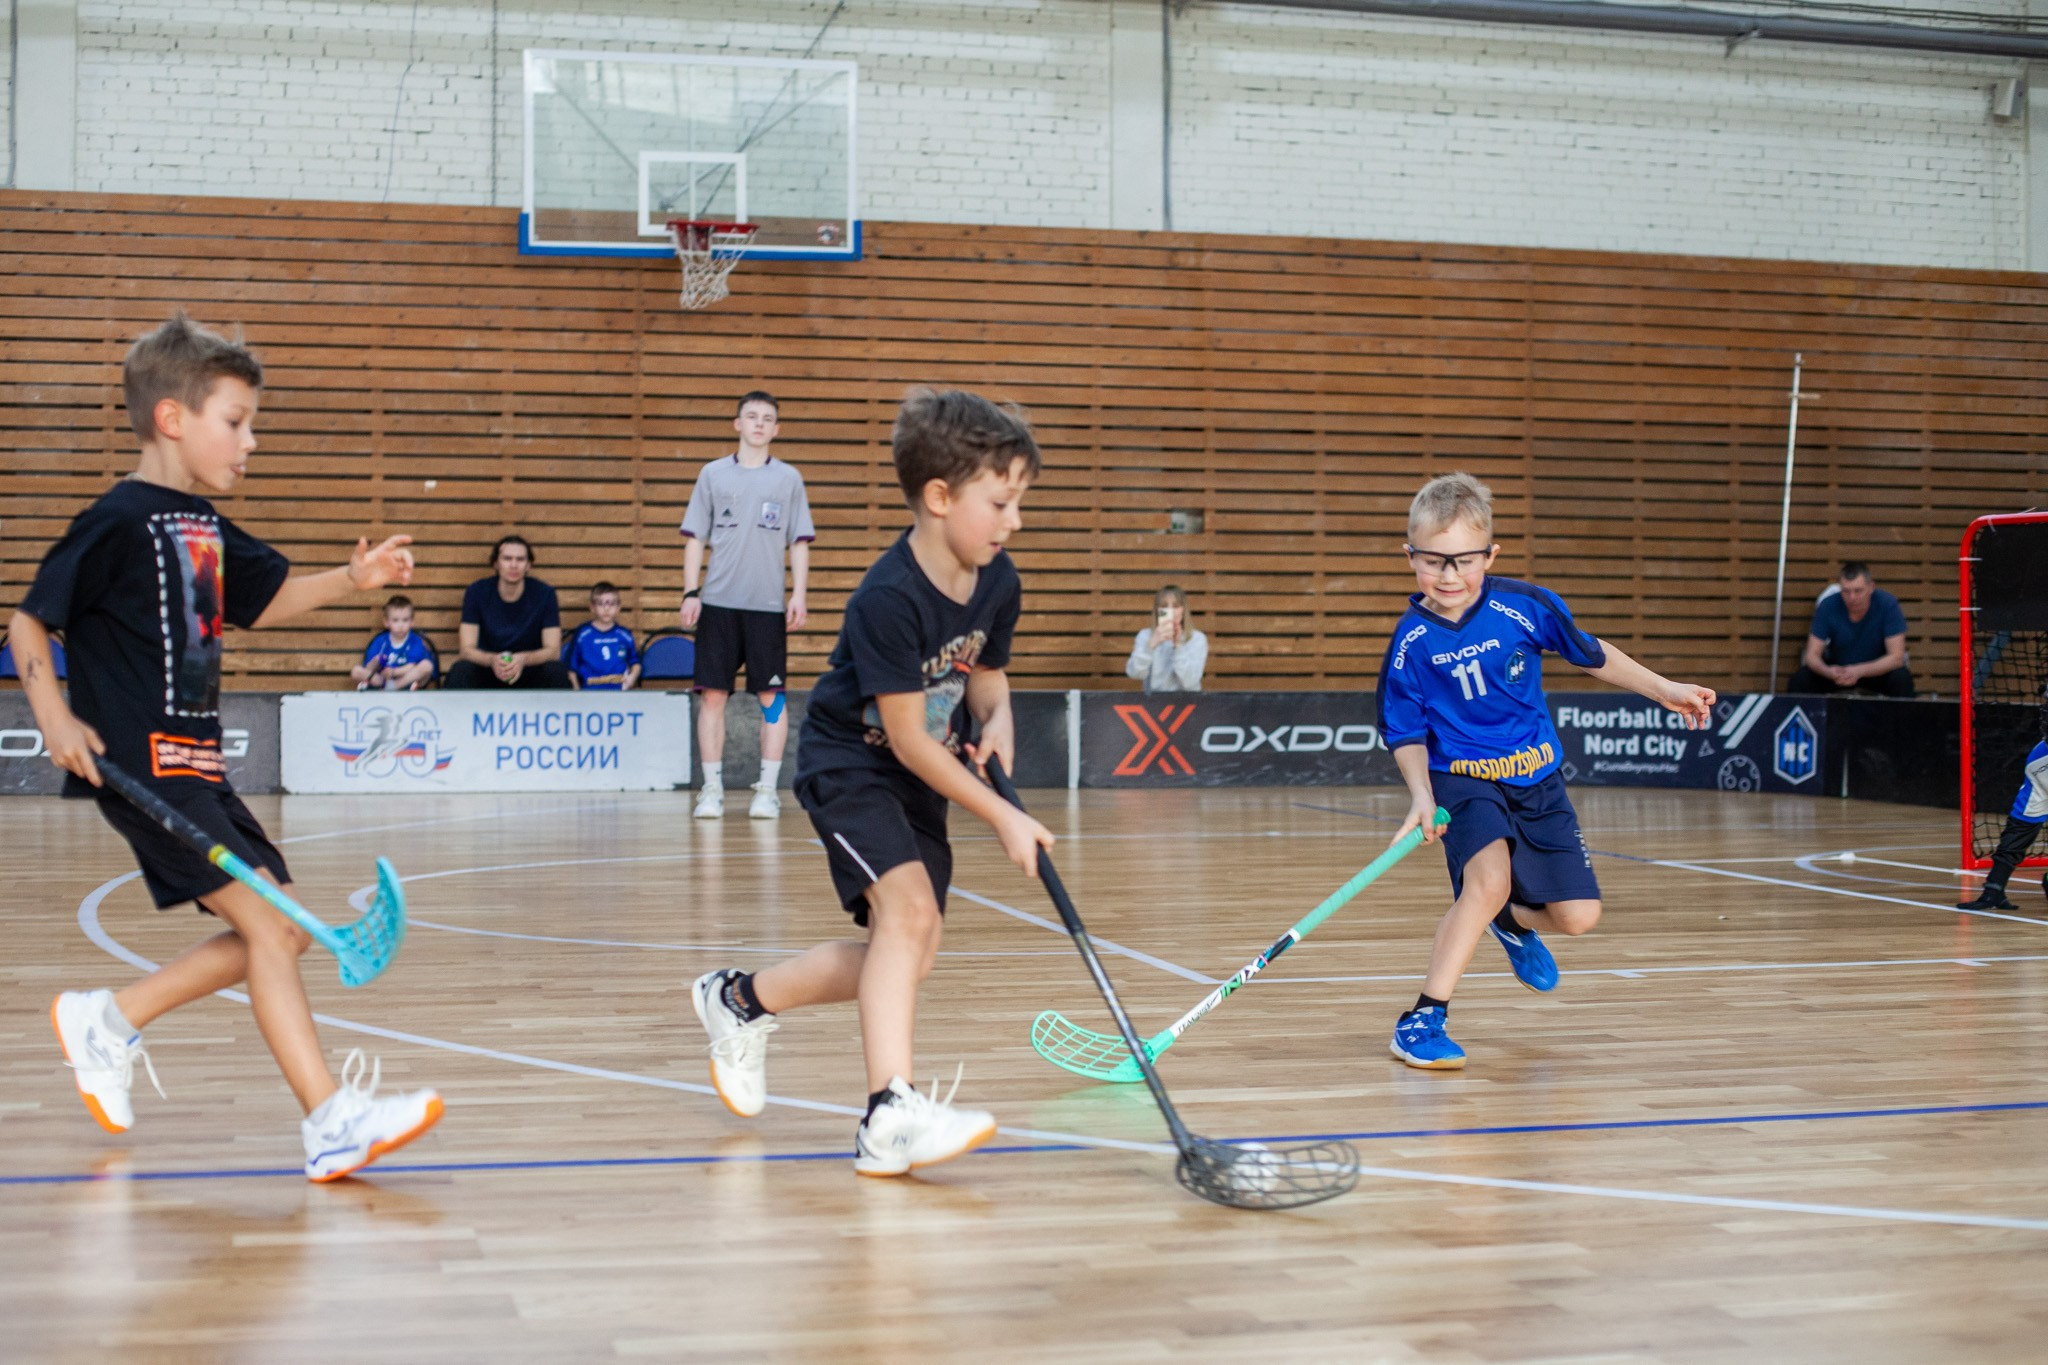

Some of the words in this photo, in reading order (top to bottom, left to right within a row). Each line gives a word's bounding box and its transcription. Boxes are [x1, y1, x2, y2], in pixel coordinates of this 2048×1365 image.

[1431, 638, 1501, 666] GIVOVA
[1450, 658, 1488, 701] 11
[472, 712, 644, 737] МИНСПОРТ
[1557, 706, 1662, 729] Floorball
[1200, 725, 1388, 753] OXDO
[1583, 733, 1640, 756] Nord
[1643, 733, 1688, 760] City
[496, 745, 619, 770] РОССИИ
[1782, 741, 1811, 764] NC
